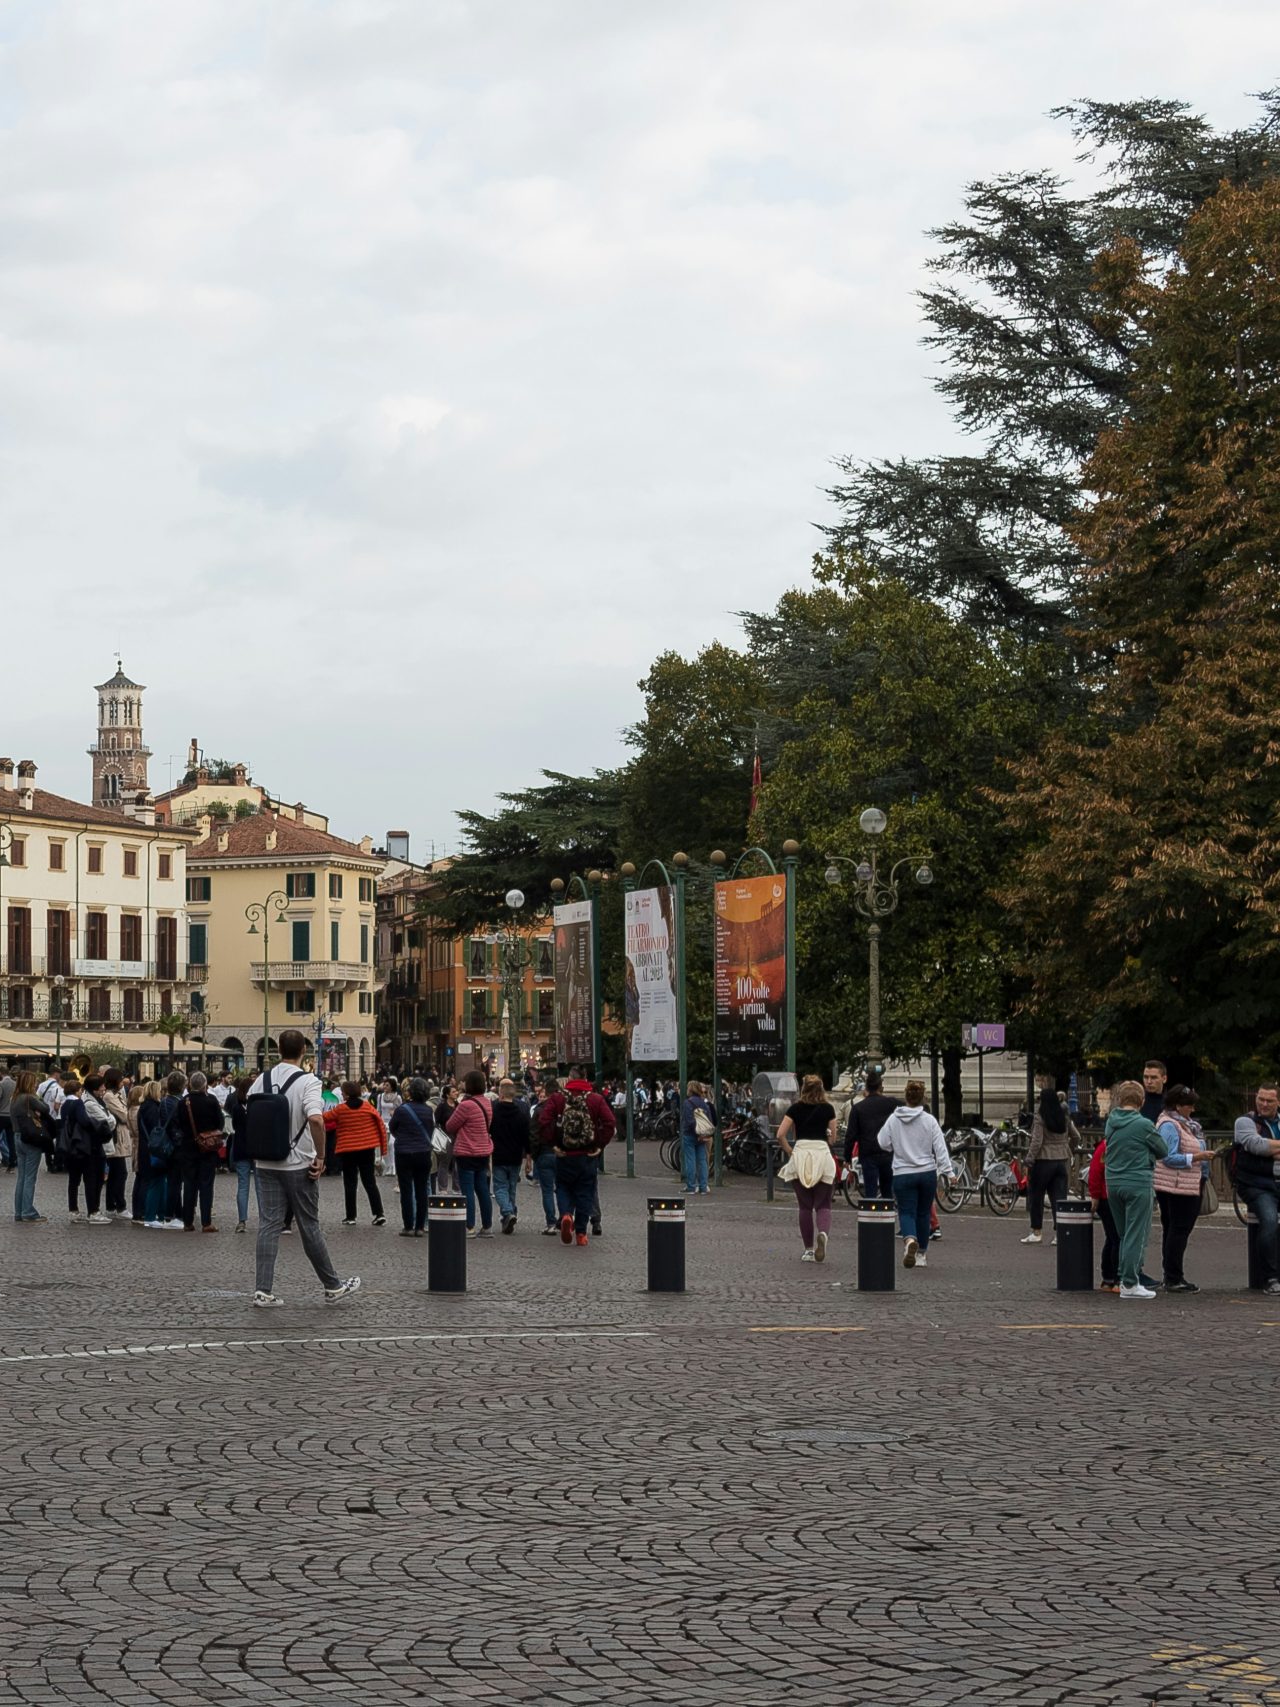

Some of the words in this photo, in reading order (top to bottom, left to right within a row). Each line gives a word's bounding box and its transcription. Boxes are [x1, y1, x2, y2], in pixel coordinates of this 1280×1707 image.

[627, 923, 649, 939] TEATRO
[628, 936, 667, 954] FILARMONICO
[635, 951, 663, 968] ABBONATI
[736, 976, 752, 1000] 100
[752, 980, 770, 999] volte
[743, 998, 766, 1021] prima
[757, 1012, 776, 1031] volta
[983, 1029, 999, 1041] WC
